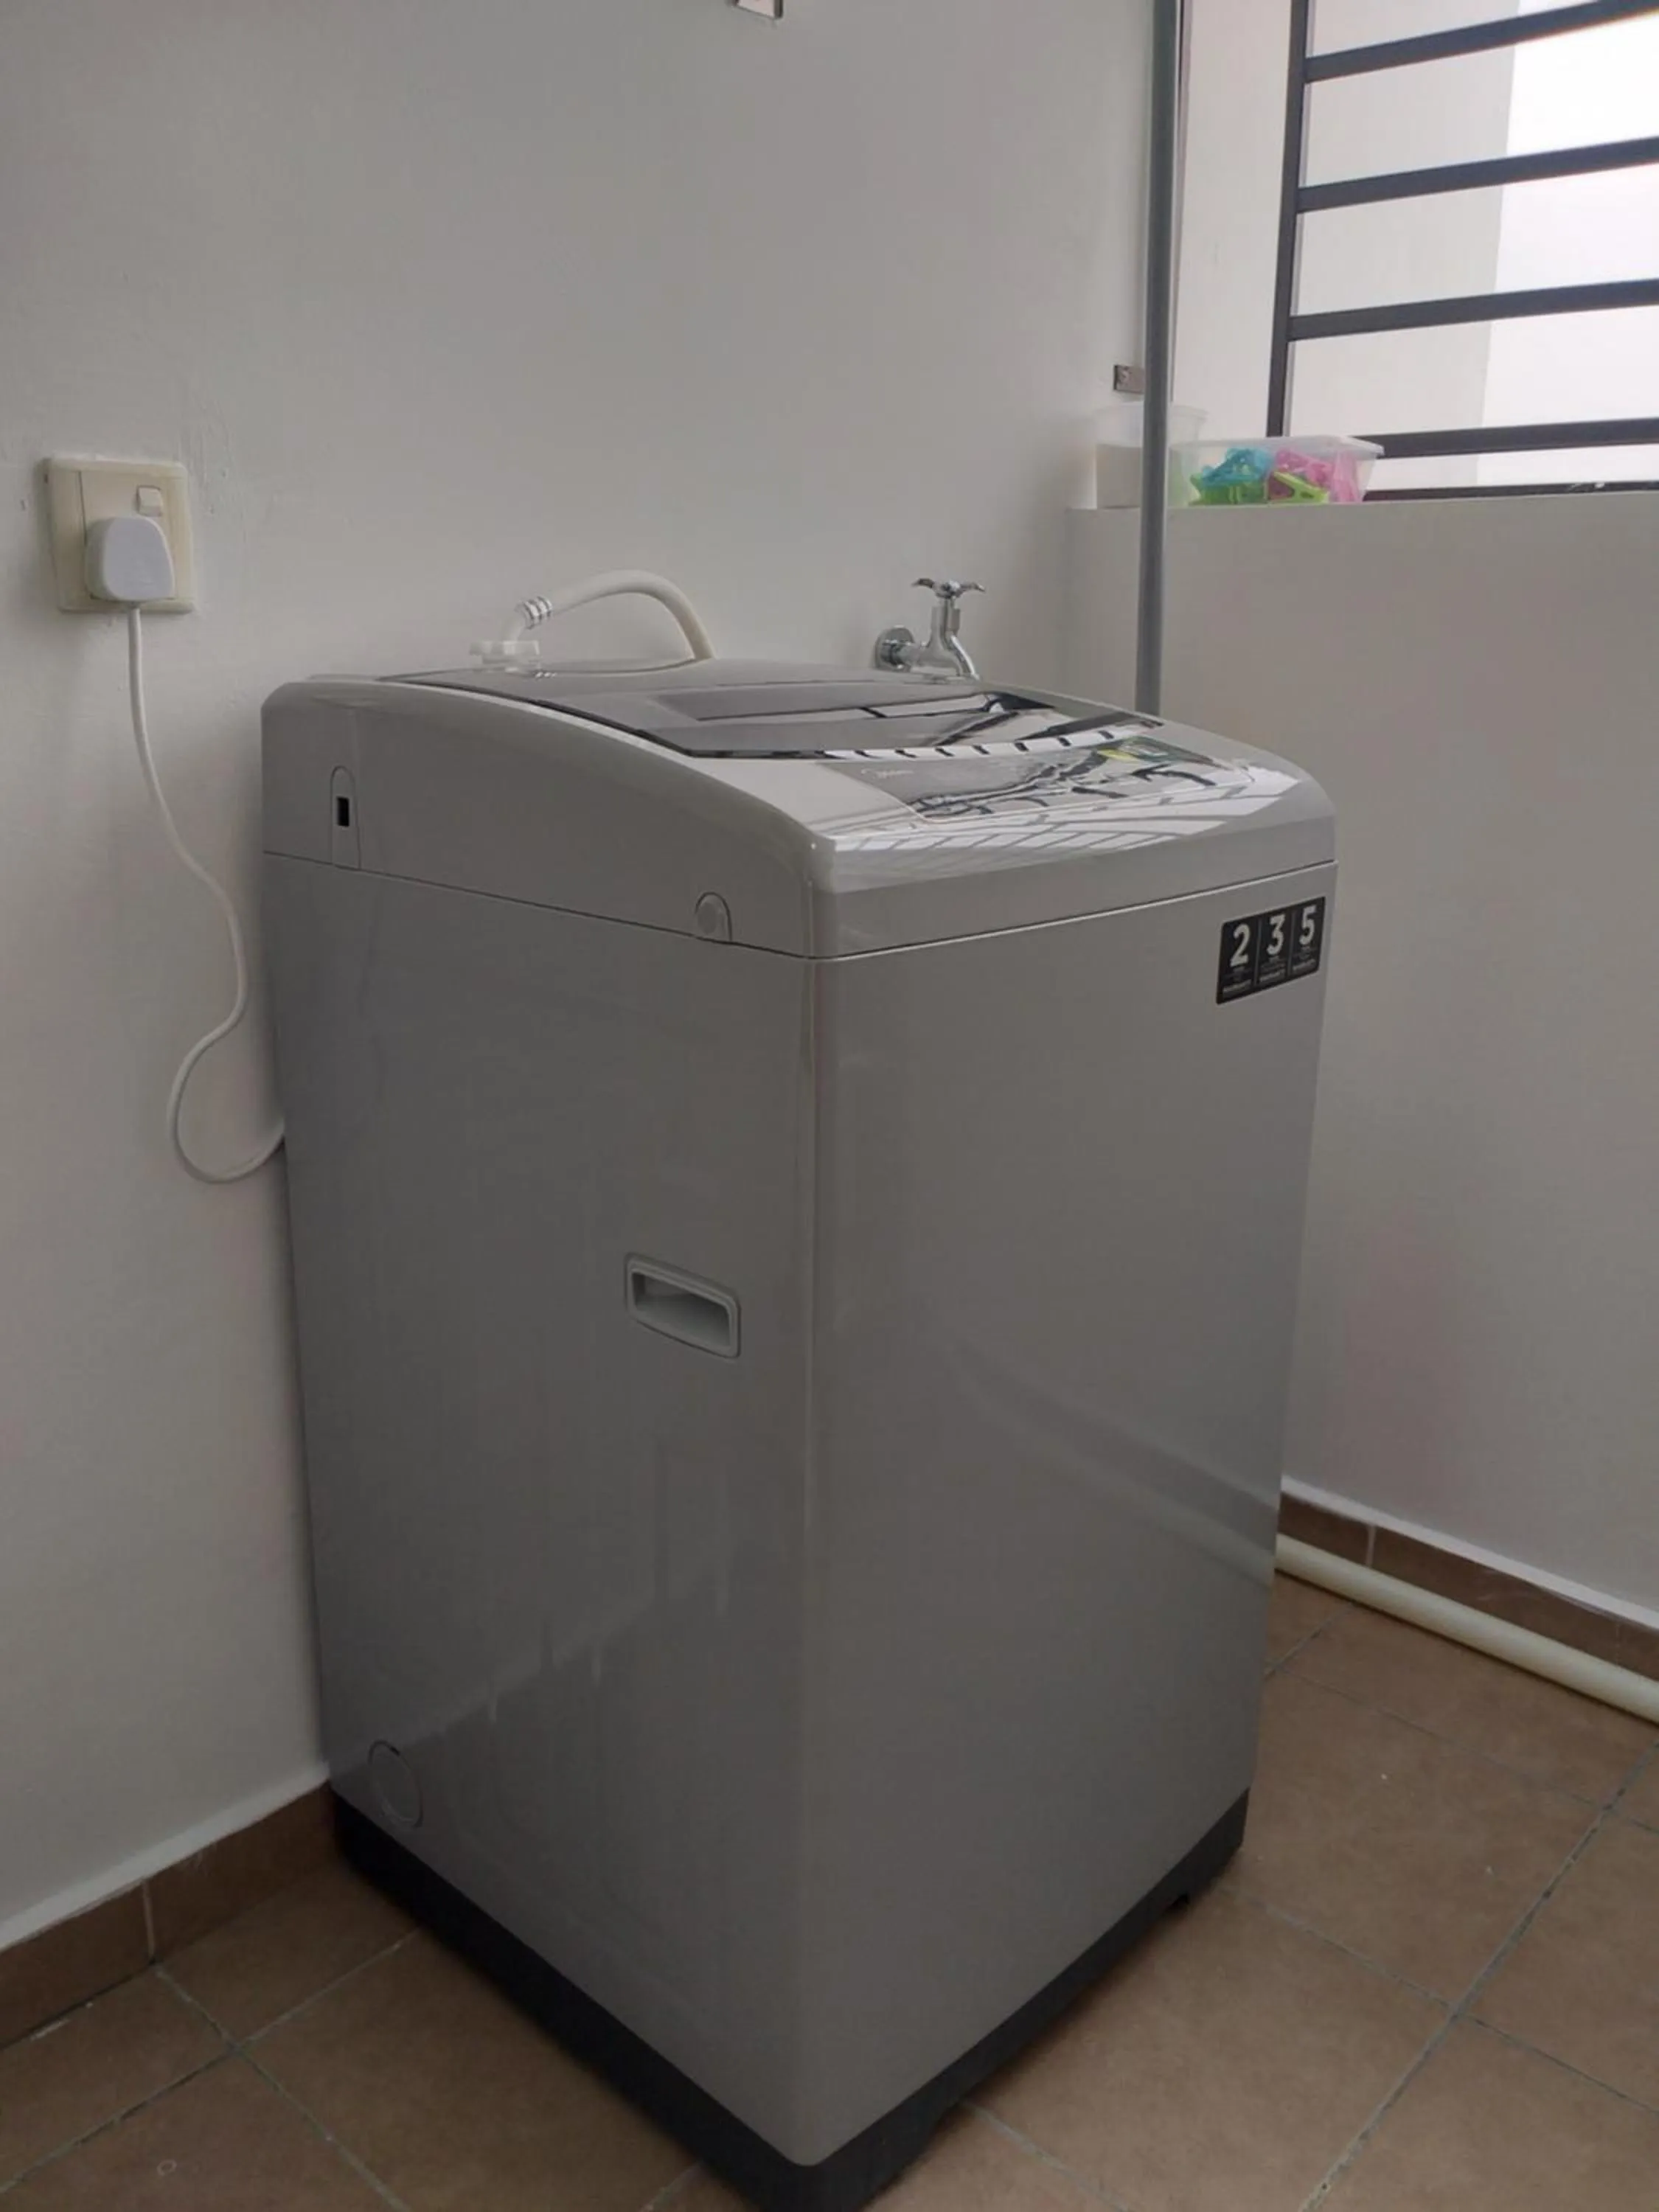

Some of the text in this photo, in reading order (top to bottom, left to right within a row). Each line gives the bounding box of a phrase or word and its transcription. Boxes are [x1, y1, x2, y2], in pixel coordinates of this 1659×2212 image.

[1230, 923, 1251, 967] 2
[1266, 914, 1285, 955] 3
[1299, 905, 1317, 945] 5
